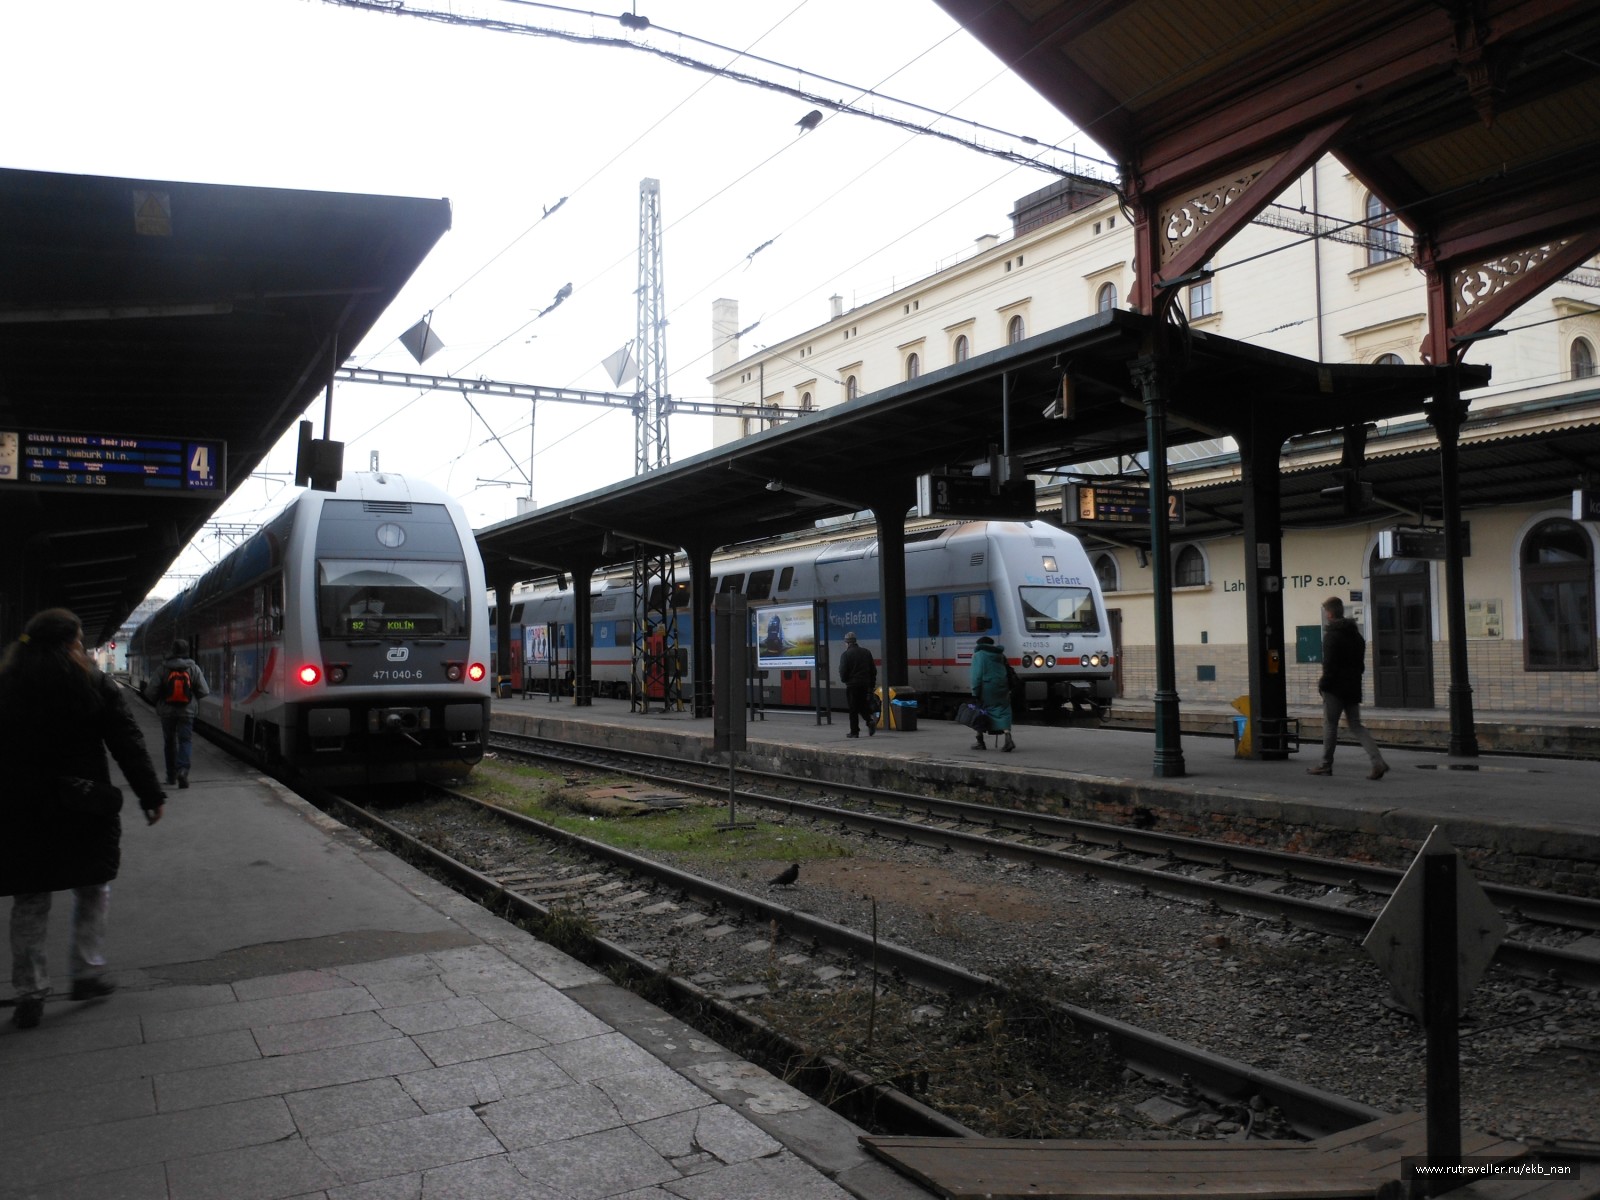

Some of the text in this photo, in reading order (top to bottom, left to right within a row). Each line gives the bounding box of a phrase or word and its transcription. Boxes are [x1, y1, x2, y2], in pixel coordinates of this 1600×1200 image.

[58, 435, 88, 445] STANICE
[100, 438, 118, 446] Směr
[85, 474, 107, 486] 9:55
[1291, 575, 1312, 588] TIP
[1316, 575, 1350, 587] s.r.o.
[373, 670, 423, 679] 471 040-6
